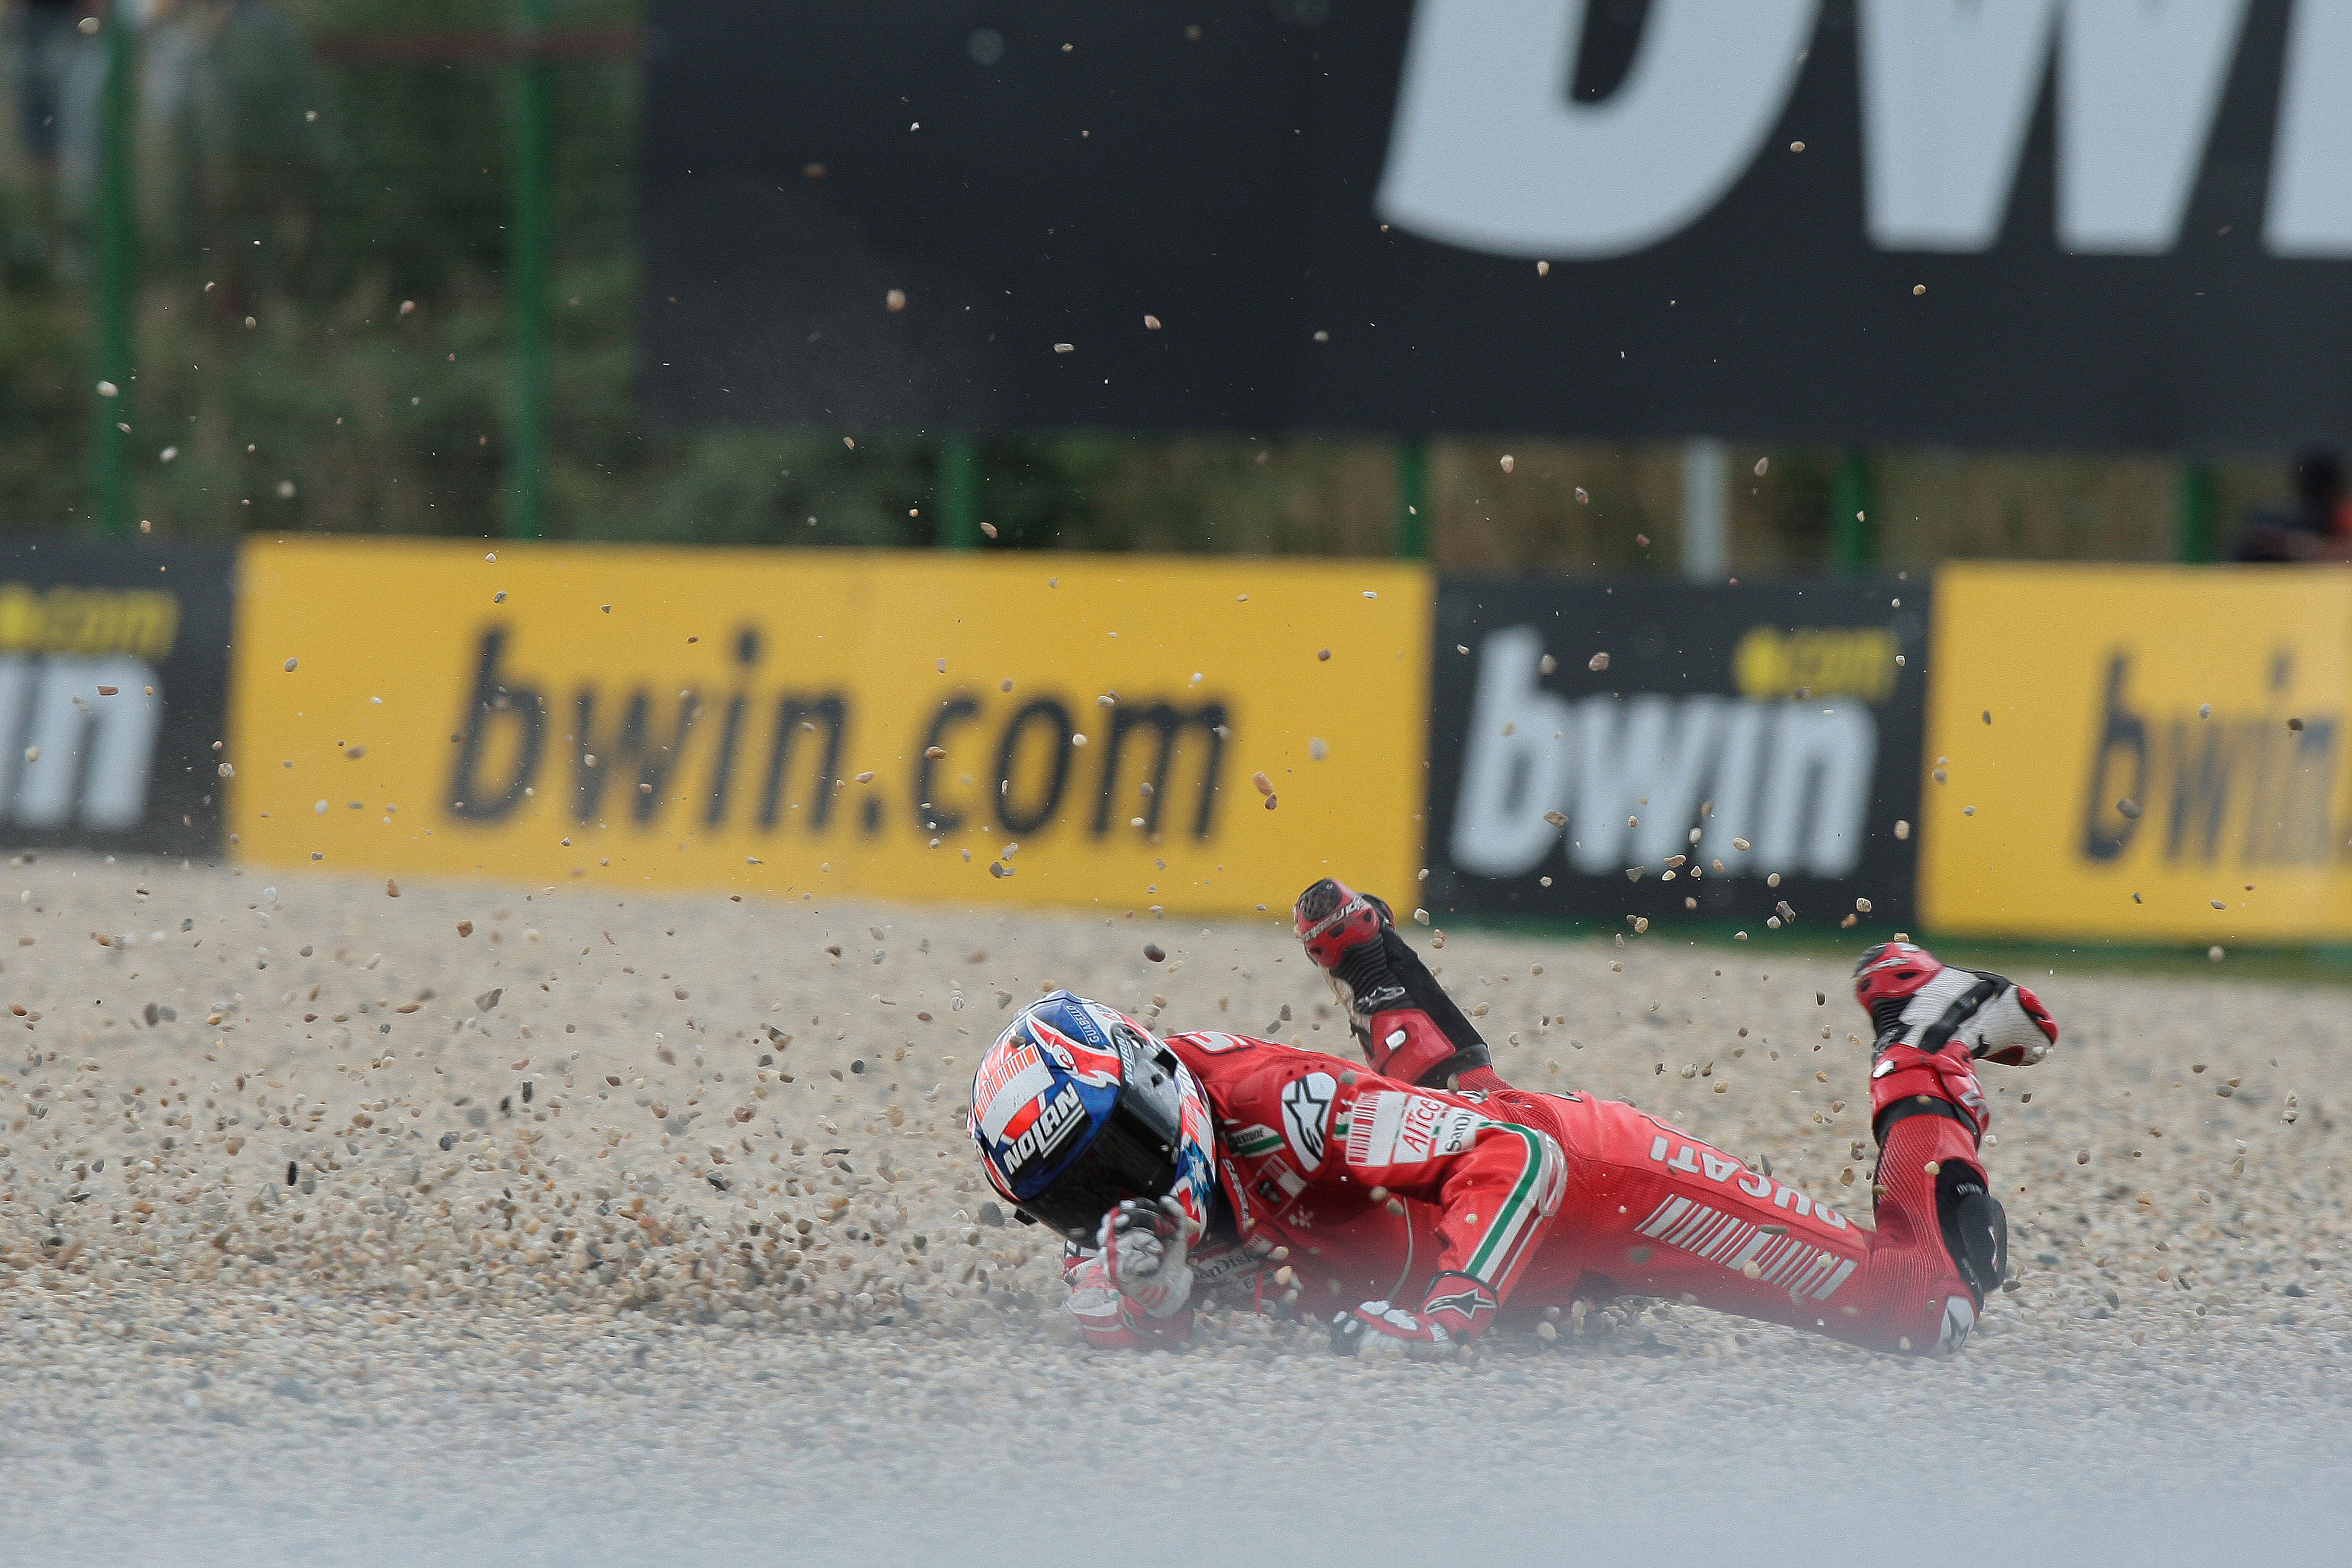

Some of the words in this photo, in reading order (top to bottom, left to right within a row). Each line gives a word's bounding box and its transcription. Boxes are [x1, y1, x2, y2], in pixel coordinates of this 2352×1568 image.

[448, 622, 1233, 838] bwin.com
[1452, 626, 1878, 876] bwin
[1115, 1035, 1135, 1086] NOLAN
[1002, 1082, 1085, 1175] NOLAN
[1650, 1135, 1846, 1230] DUCATI
